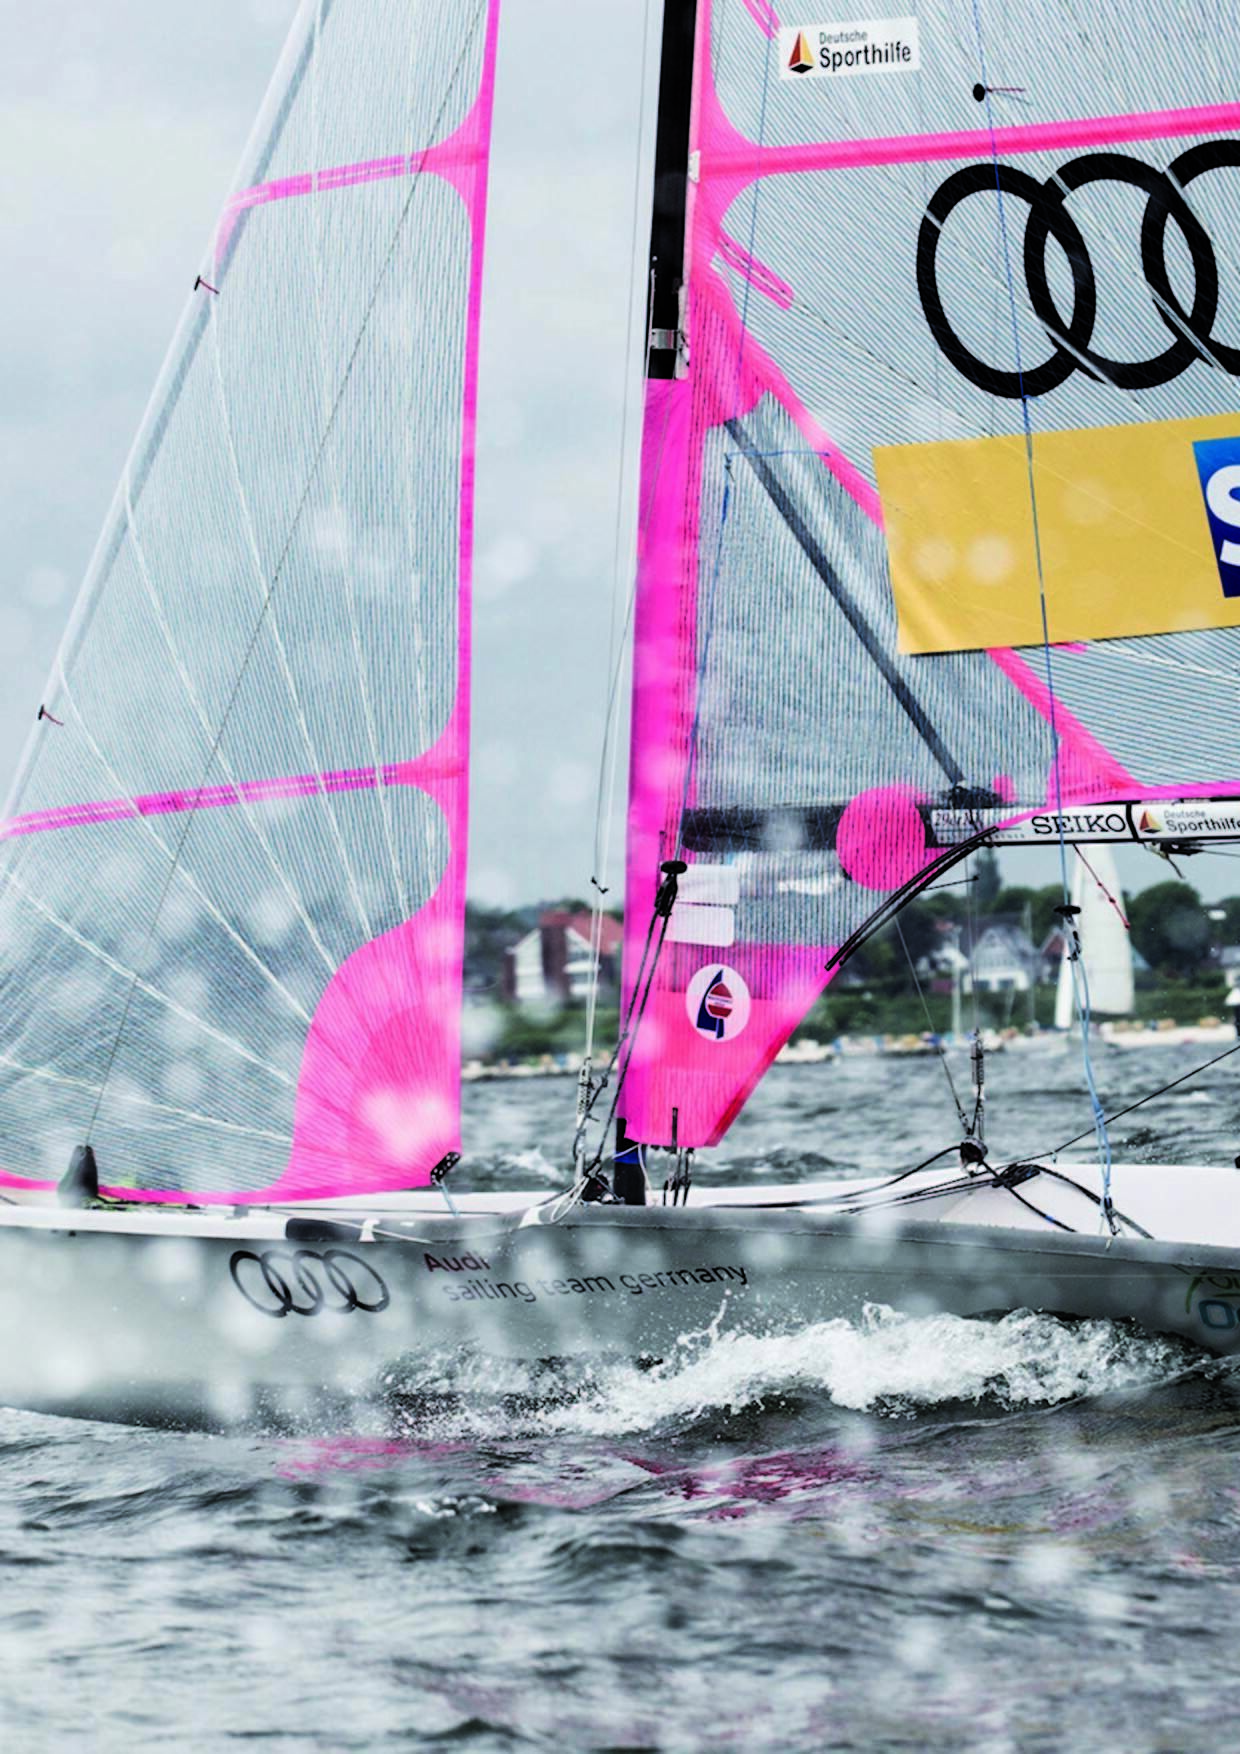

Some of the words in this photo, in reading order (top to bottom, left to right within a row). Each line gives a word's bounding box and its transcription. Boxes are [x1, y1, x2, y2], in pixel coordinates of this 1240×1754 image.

[819, 30, 868, 45] Deutsche
[819, 41, 912, 72] Sporthilfe
[1031, 813, 1126, 835] SEIKO
[1163, 809, 1207, 819] Deutsche
[423, 1251, 491, 1273] Audi
[441, 1279, 536, 1302] sailing
[538, 1271, 616, 1297] team
[619, 1264, 749, 1295] germany
